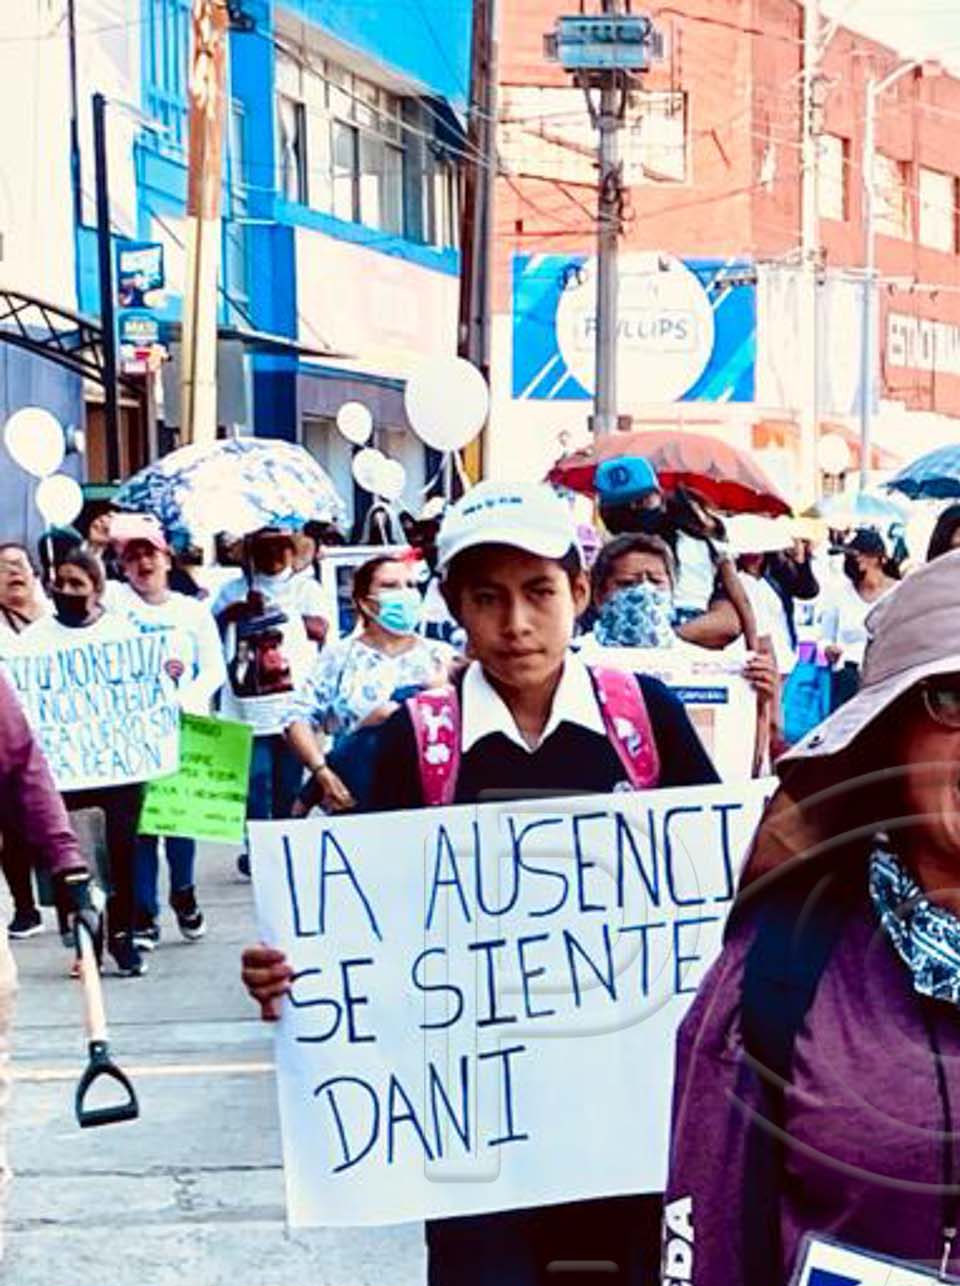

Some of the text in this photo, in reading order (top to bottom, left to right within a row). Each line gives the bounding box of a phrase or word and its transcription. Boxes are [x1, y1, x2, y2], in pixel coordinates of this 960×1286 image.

[282, 829, 383, 941] LA
[288, 916, 720, 1044] SE SIENTE
[313, 1044, 529, 1173] DANI
